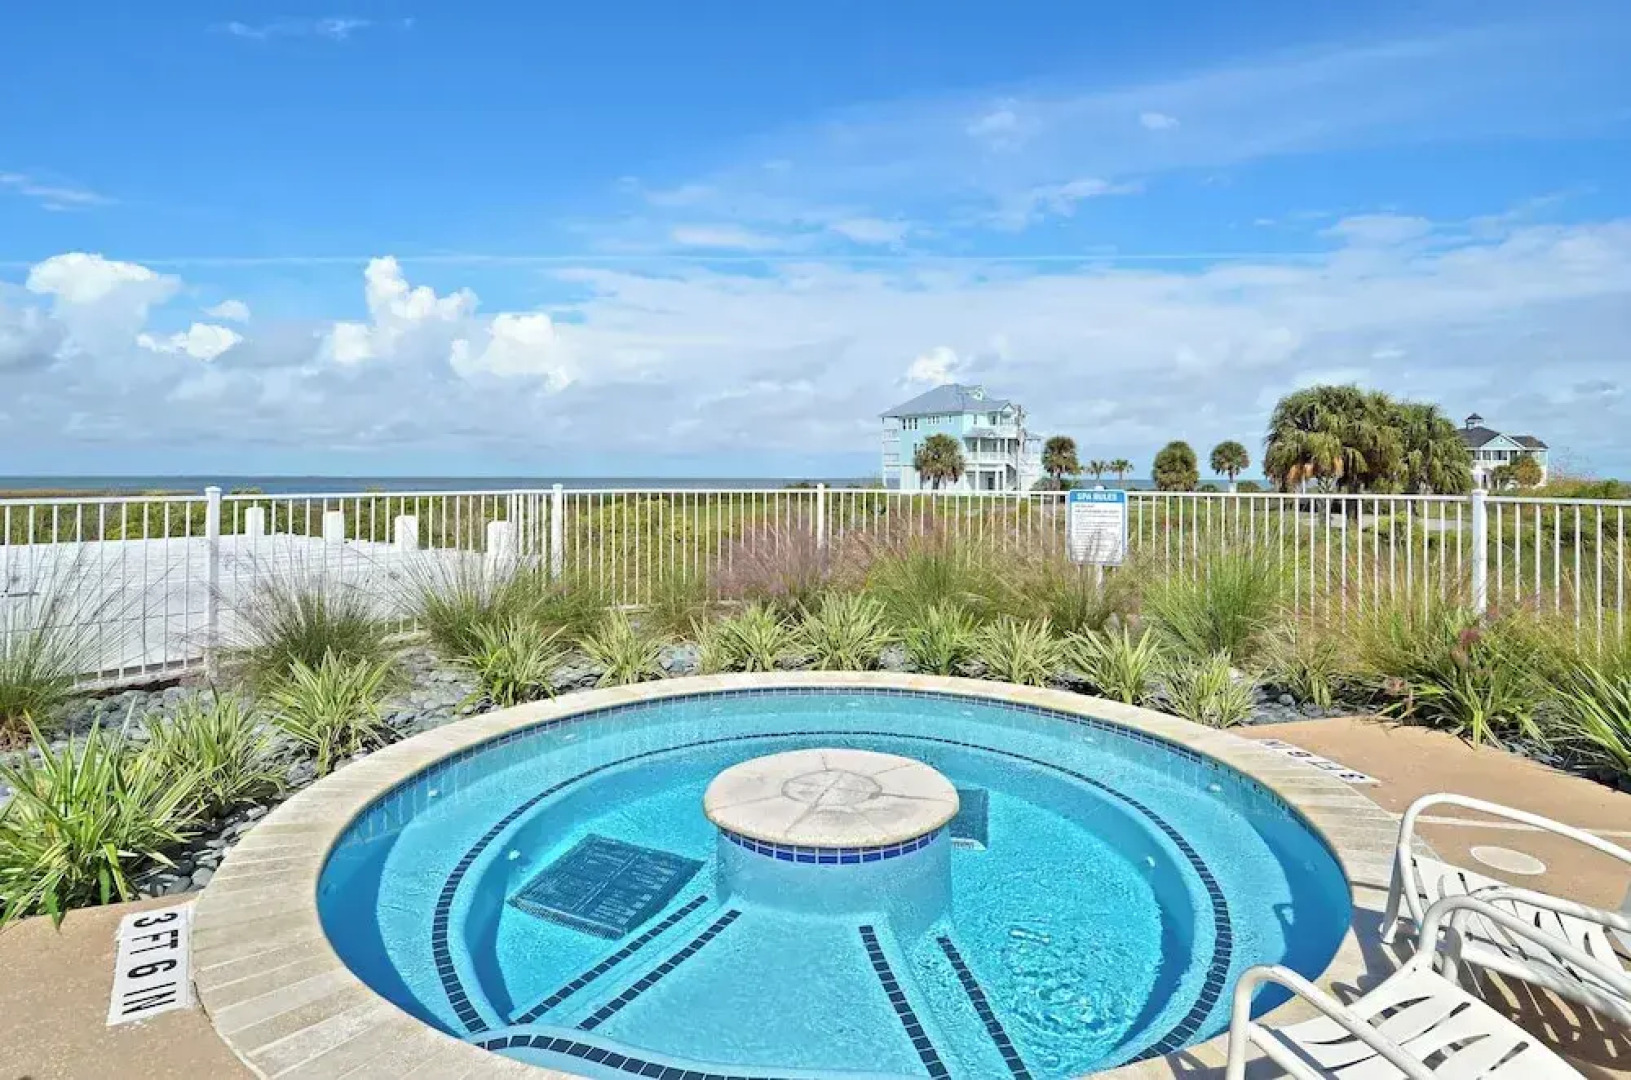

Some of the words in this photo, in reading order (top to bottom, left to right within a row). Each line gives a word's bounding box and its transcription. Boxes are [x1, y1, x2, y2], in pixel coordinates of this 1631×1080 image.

[1077, 492, 1092, 500] SPA
[1093, 492, 1117, 500] RULES
[133, 912, 178, 927] 3
[130, 930, 179, 955] FT
[127, 959, 177, 978] 6
[122, 982, 177, 1015] IN
